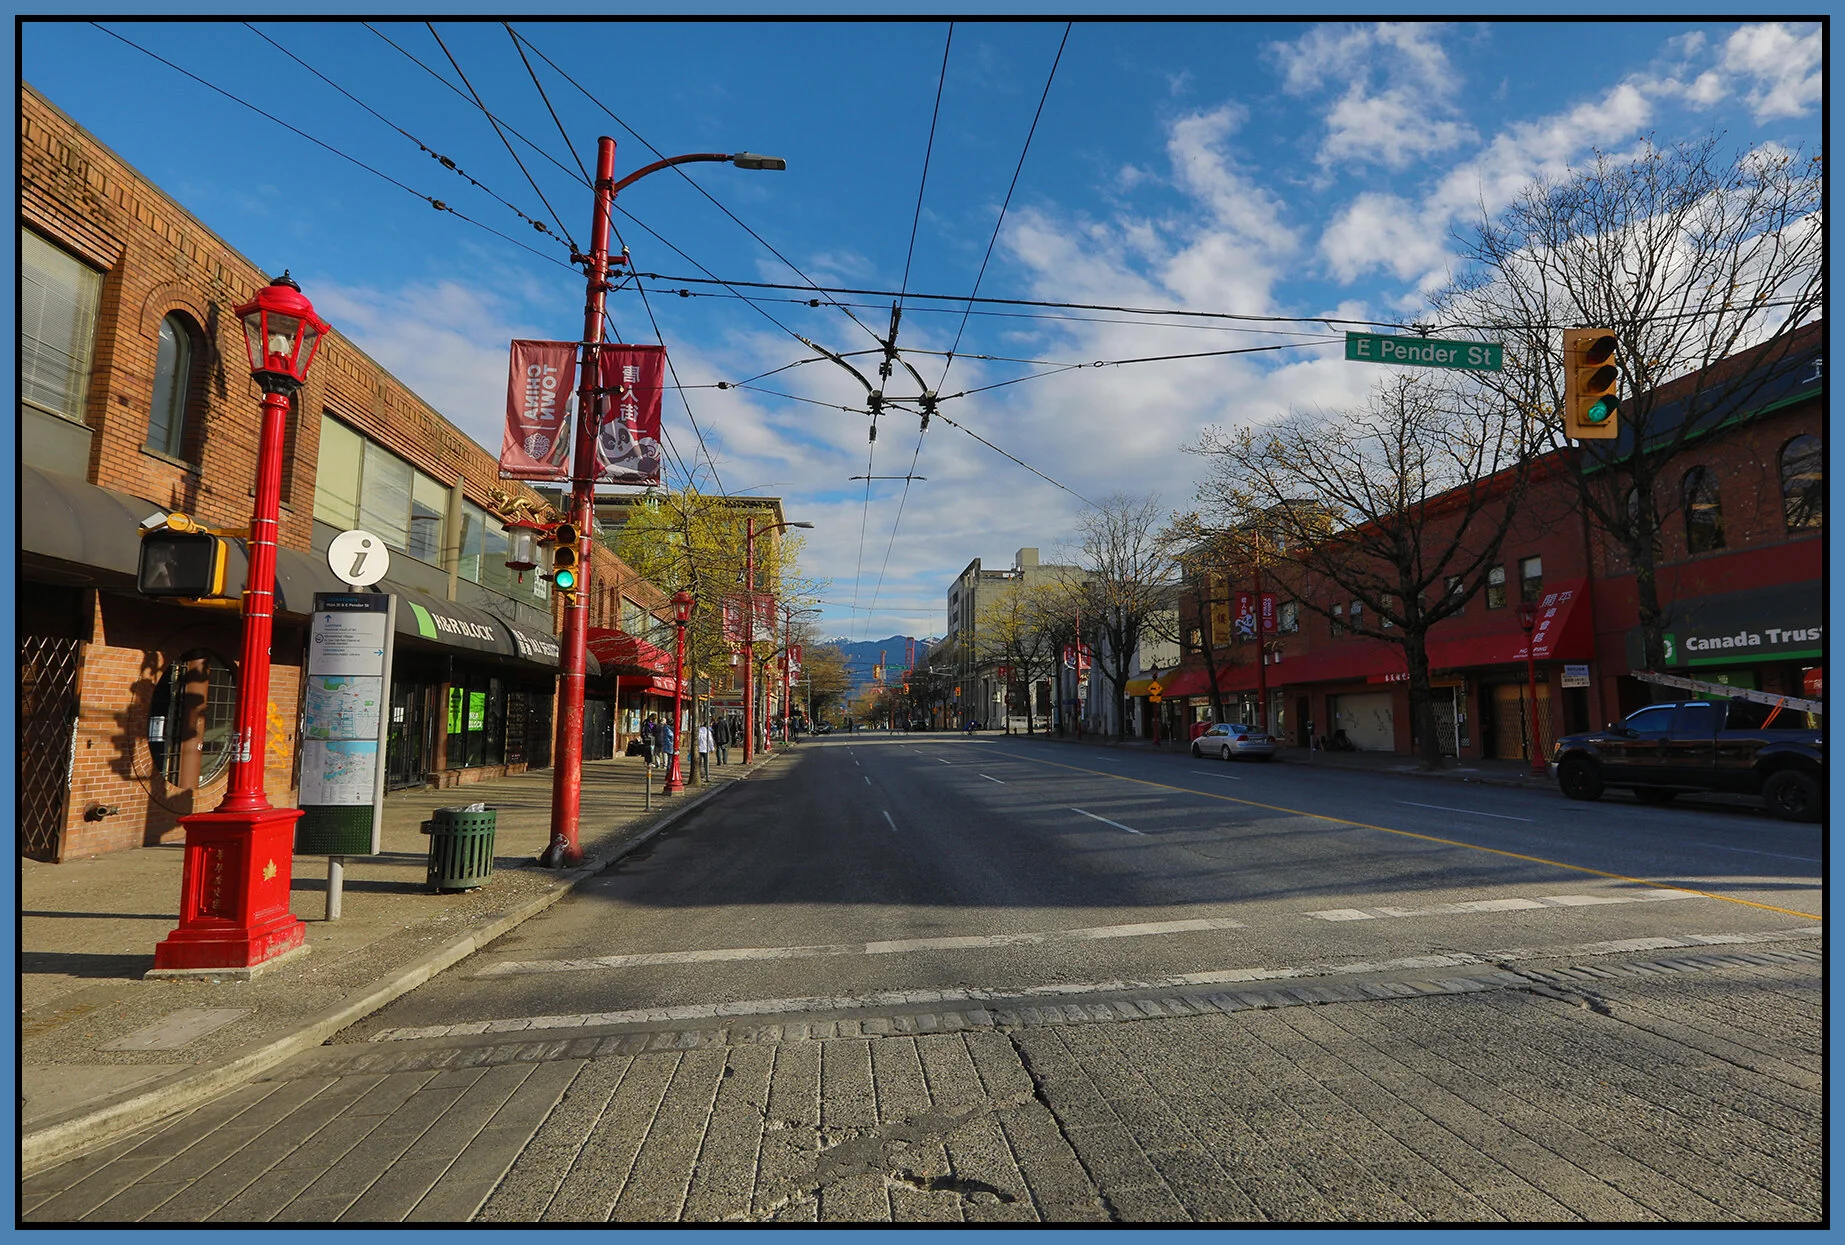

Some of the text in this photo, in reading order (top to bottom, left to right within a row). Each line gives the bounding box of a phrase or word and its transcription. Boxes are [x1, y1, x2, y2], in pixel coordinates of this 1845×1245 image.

[1357, 338, 1491, 366] E Pender St
[431, 612, 495, 642] H&R BLOCK
[1685, 630, 1761, 651] Canada
